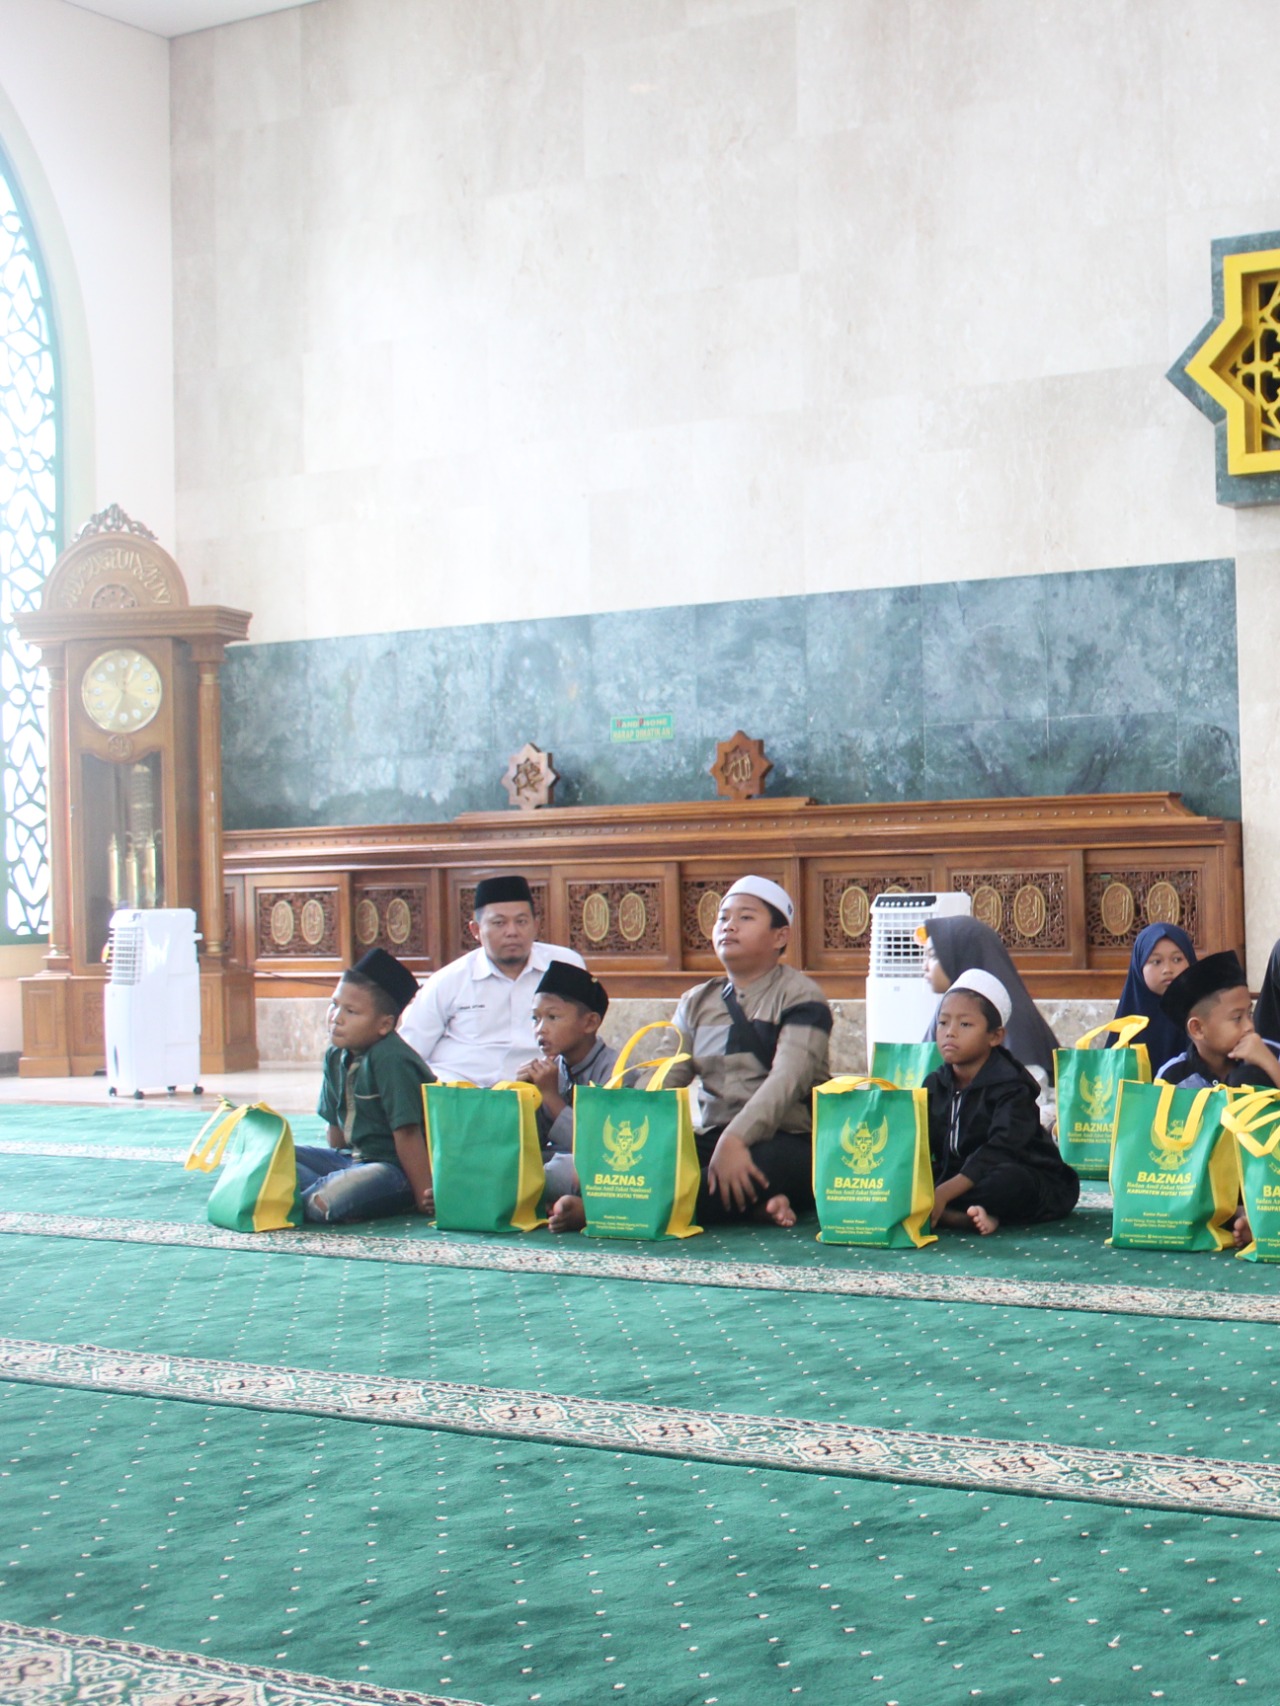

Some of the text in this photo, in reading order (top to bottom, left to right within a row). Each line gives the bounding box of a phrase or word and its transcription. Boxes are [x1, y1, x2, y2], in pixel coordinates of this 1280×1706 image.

[594, 1173, 645, 1187] BAZNAS
[834, 1177, 884, 1189] BAZNAS
[1137, 1170, 1192, 1184] BAZNAS
